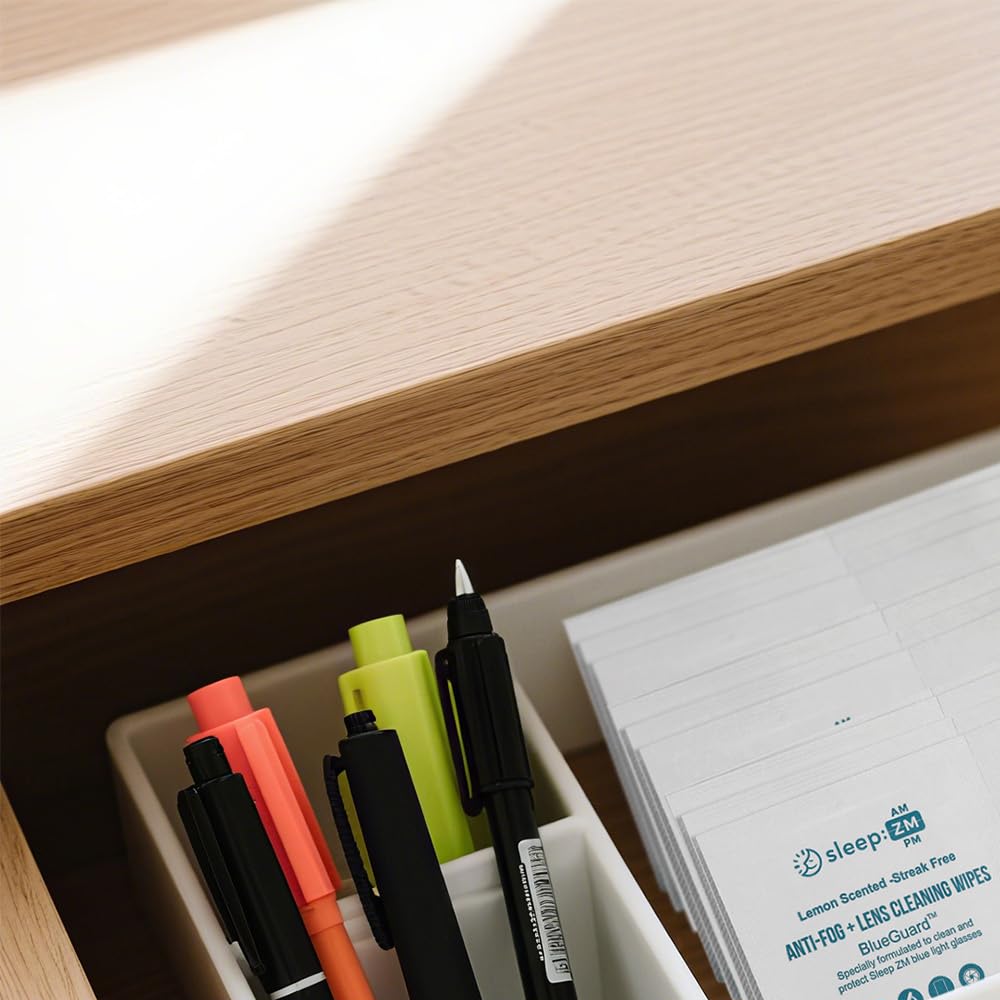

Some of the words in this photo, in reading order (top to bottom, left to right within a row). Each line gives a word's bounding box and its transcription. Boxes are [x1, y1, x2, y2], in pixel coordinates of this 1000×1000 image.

[891, 803, 909, 817] AM
[891, 816, 919, 836] ZM
[903, 834, 922, 848] PM
[785, 923, 846, 961] ANTI-FOG
[855, 905, 891, 932] LENS
[889, 881, 953, 918] CLEANING
[950, 865, 992, 893] WIPES
[797, 899, 839, 922] Lemon
[839, 877, 888, 904] Scented
[929, 853, 956, 869] Free
[837, 960, 876, 981] Specially
[876, 939, 922, 964] formulated
[922, 936, 932, 947] to
[933, 927, 957, 941] clean
[957, 918, 974, 932] and
[838, 975, 869, 994] protect
[869, 965, 895, 981] Sleep
[896, 957, 911, 970] ZM
[911, 951, 930, 964] blue
[930, 942, 950, 956] light
[950, 930, 983, 949] glasses
